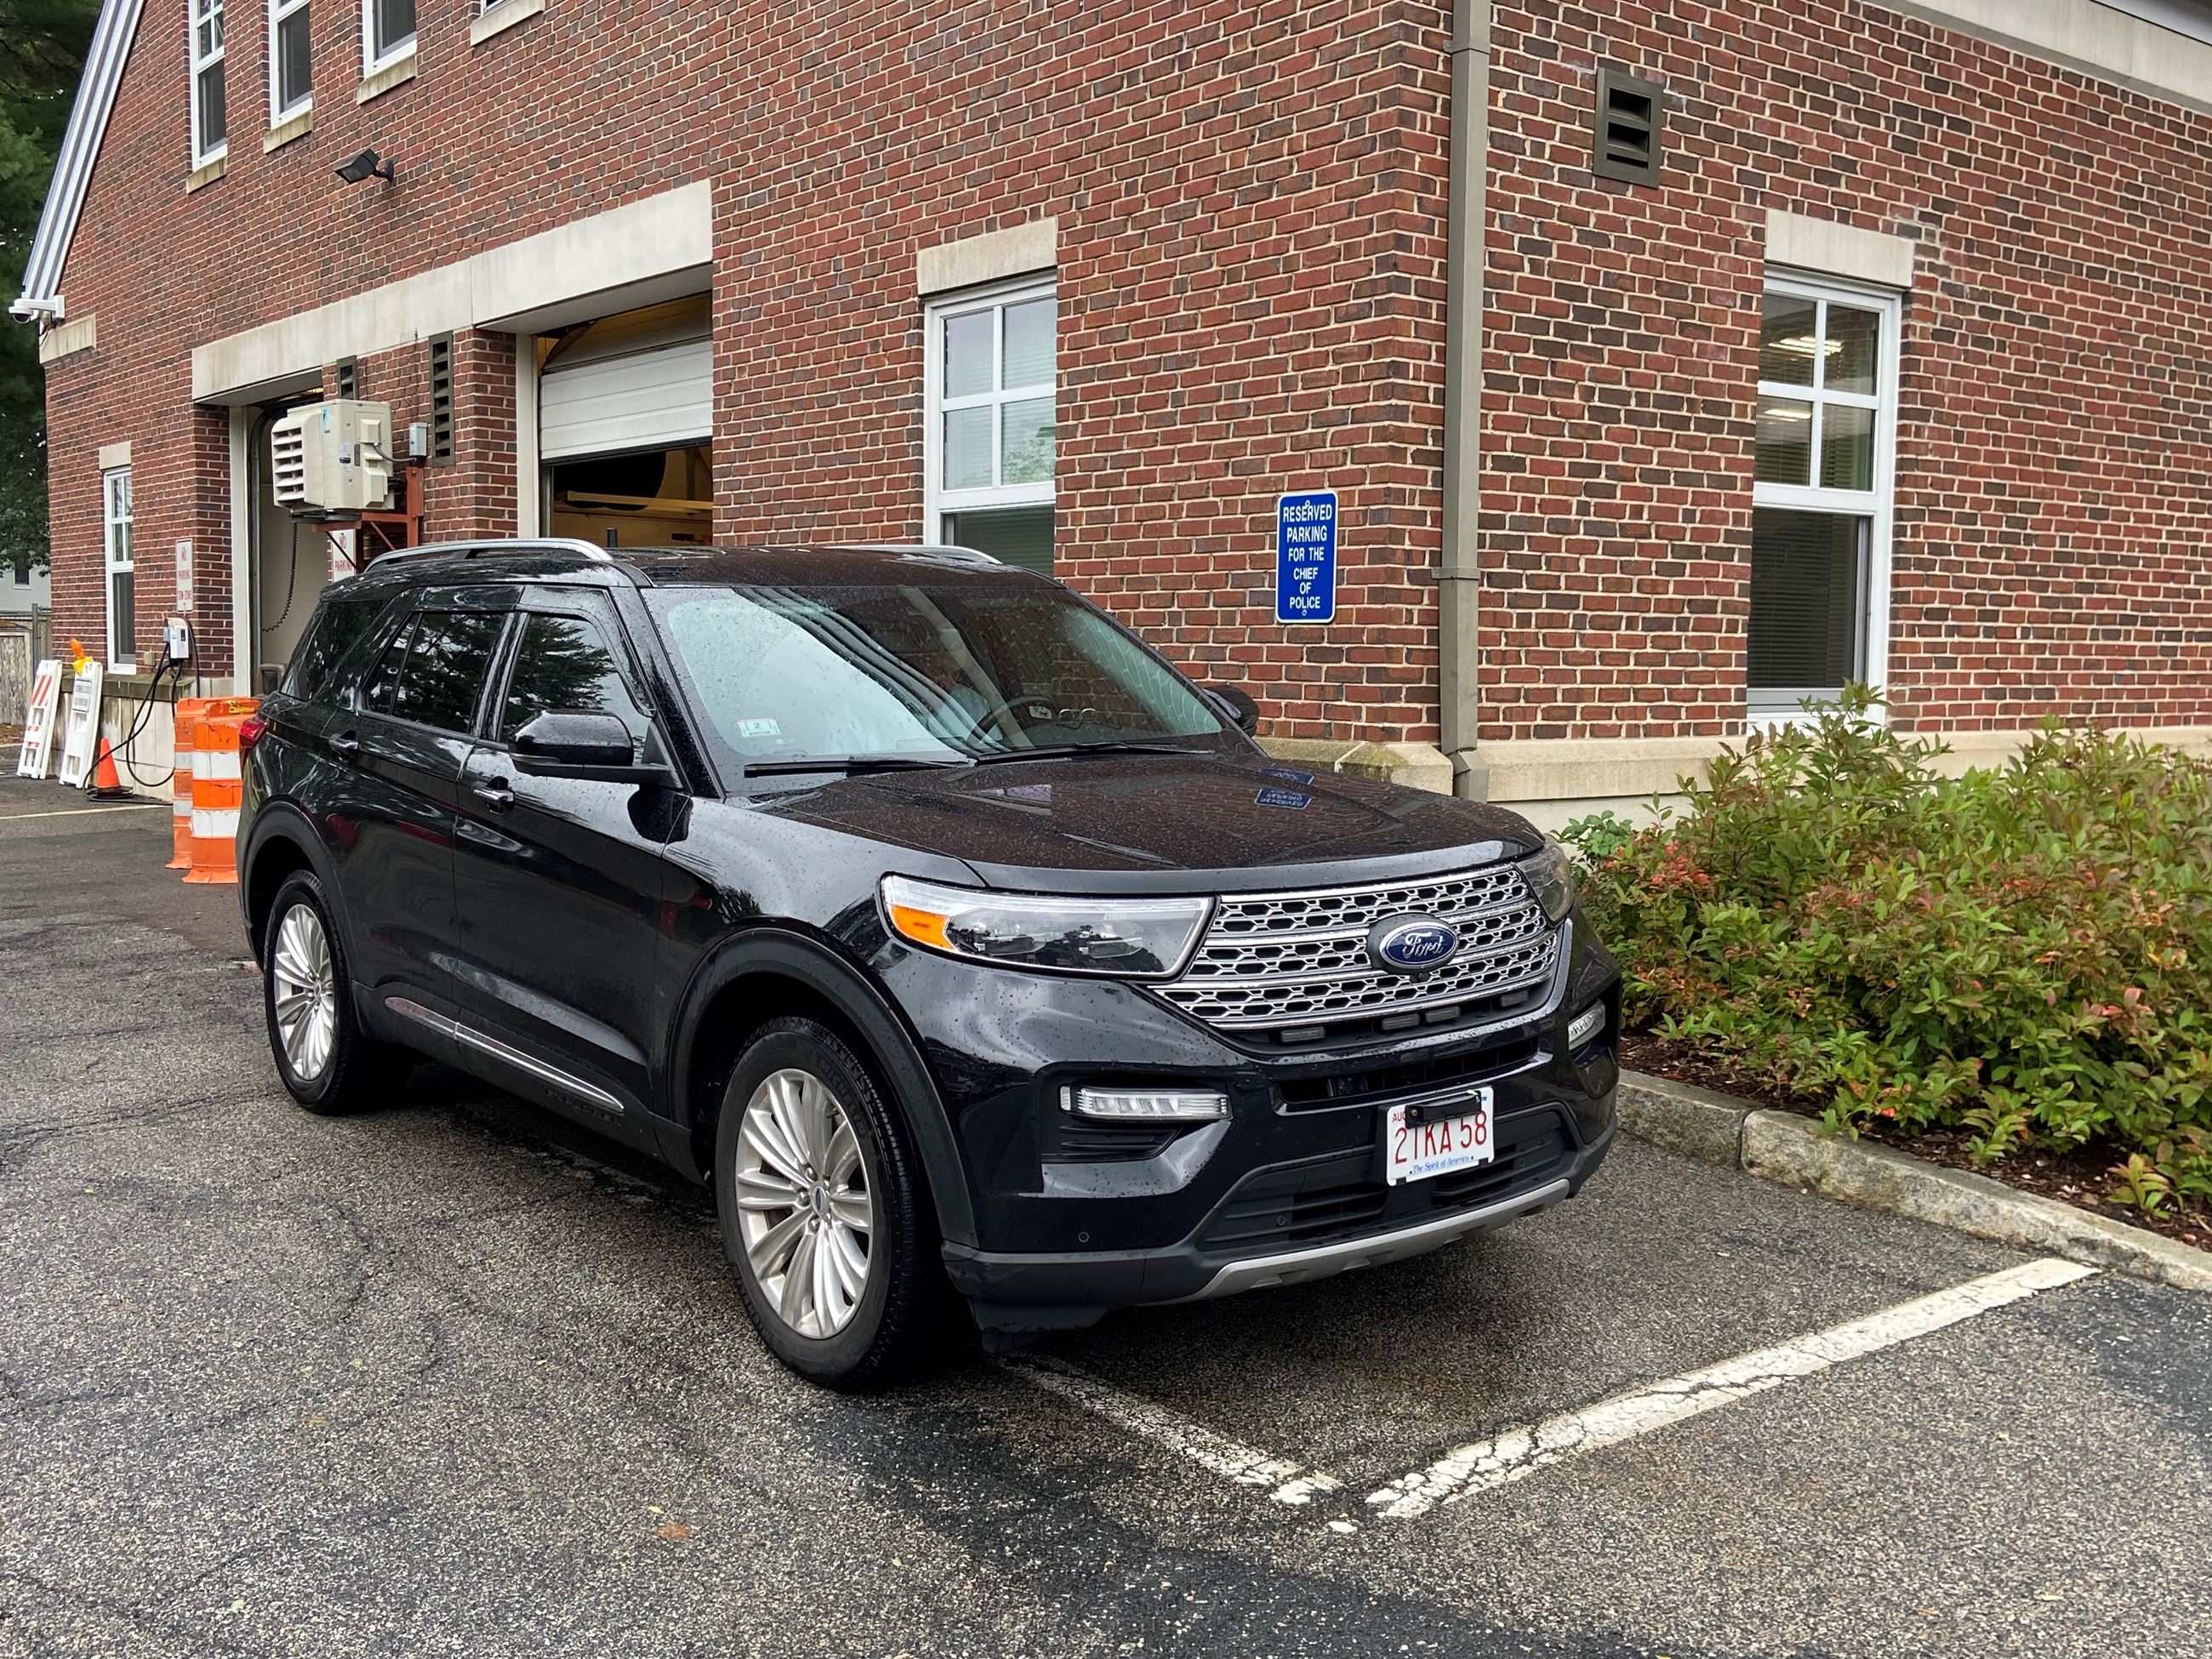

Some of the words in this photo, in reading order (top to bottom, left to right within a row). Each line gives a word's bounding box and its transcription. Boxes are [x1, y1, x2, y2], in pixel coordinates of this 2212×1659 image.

[1283, 504, 1332, 522] RESERVED
[1286, 525, 1327, 543] PARKING
[1288, 548, 1305, 562] FOR
[1308, 546, 1325, 562] THE
[1293, 567, 1319, 580] CHIEF
[1299, 582, 1312, 595] OF
[1290, 596, 1320, 609] POLICE
[1402, 932, 1444, 959] Ford
[1460, 1109, 1487, 1149] 58
[1425, 1160, 1439, 1171] Spirit
[1440, 1159, 1446, 1168] of
